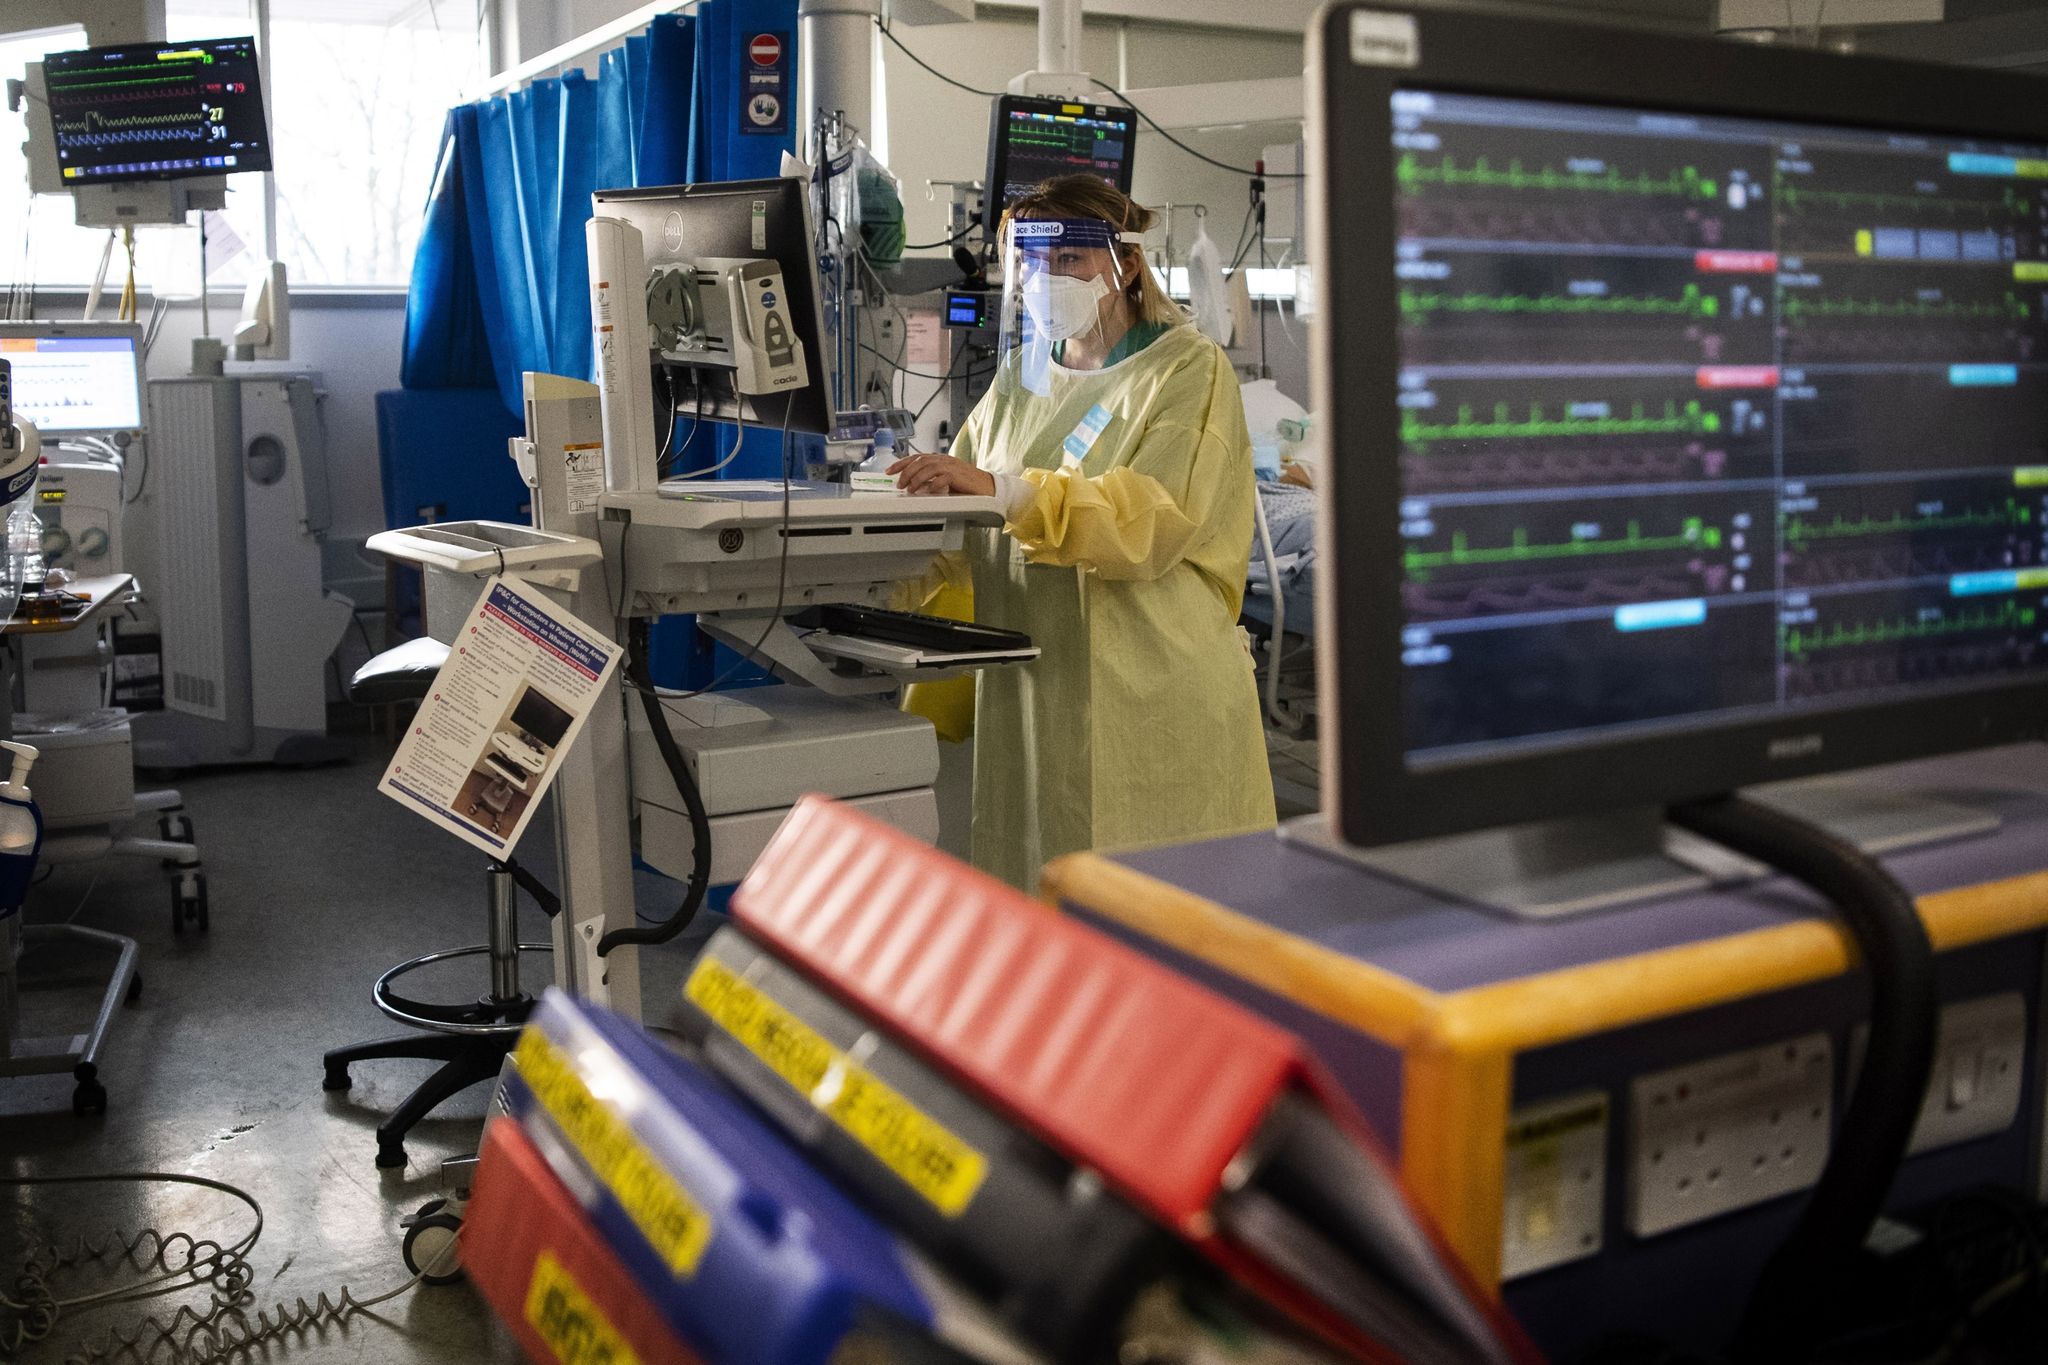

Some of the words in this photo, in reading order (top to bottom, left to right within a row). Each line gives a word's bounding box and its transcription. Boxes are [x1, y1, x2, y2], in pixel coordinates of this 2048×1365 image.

[208, 107, 225, 122] 27
[211, 125, 227, 139] 91
[664, 226, 681, 236] DELL
[1030, 225, 1060, 234] Shield
[772, 375, 798, 385] code
[506, 604, 540, 630] Workstation
[539, 627, 547, 635] on
[547, 632, 569, 650] Wheels
[510, 595, 520, 605] for
[519, 602, 549, 625] computers
[548, 621, 555, 629] in
[555, 626, 575, 643] Patient
[575, 639, 589, 652] Care
[589, 648, 606, 663] Areas
